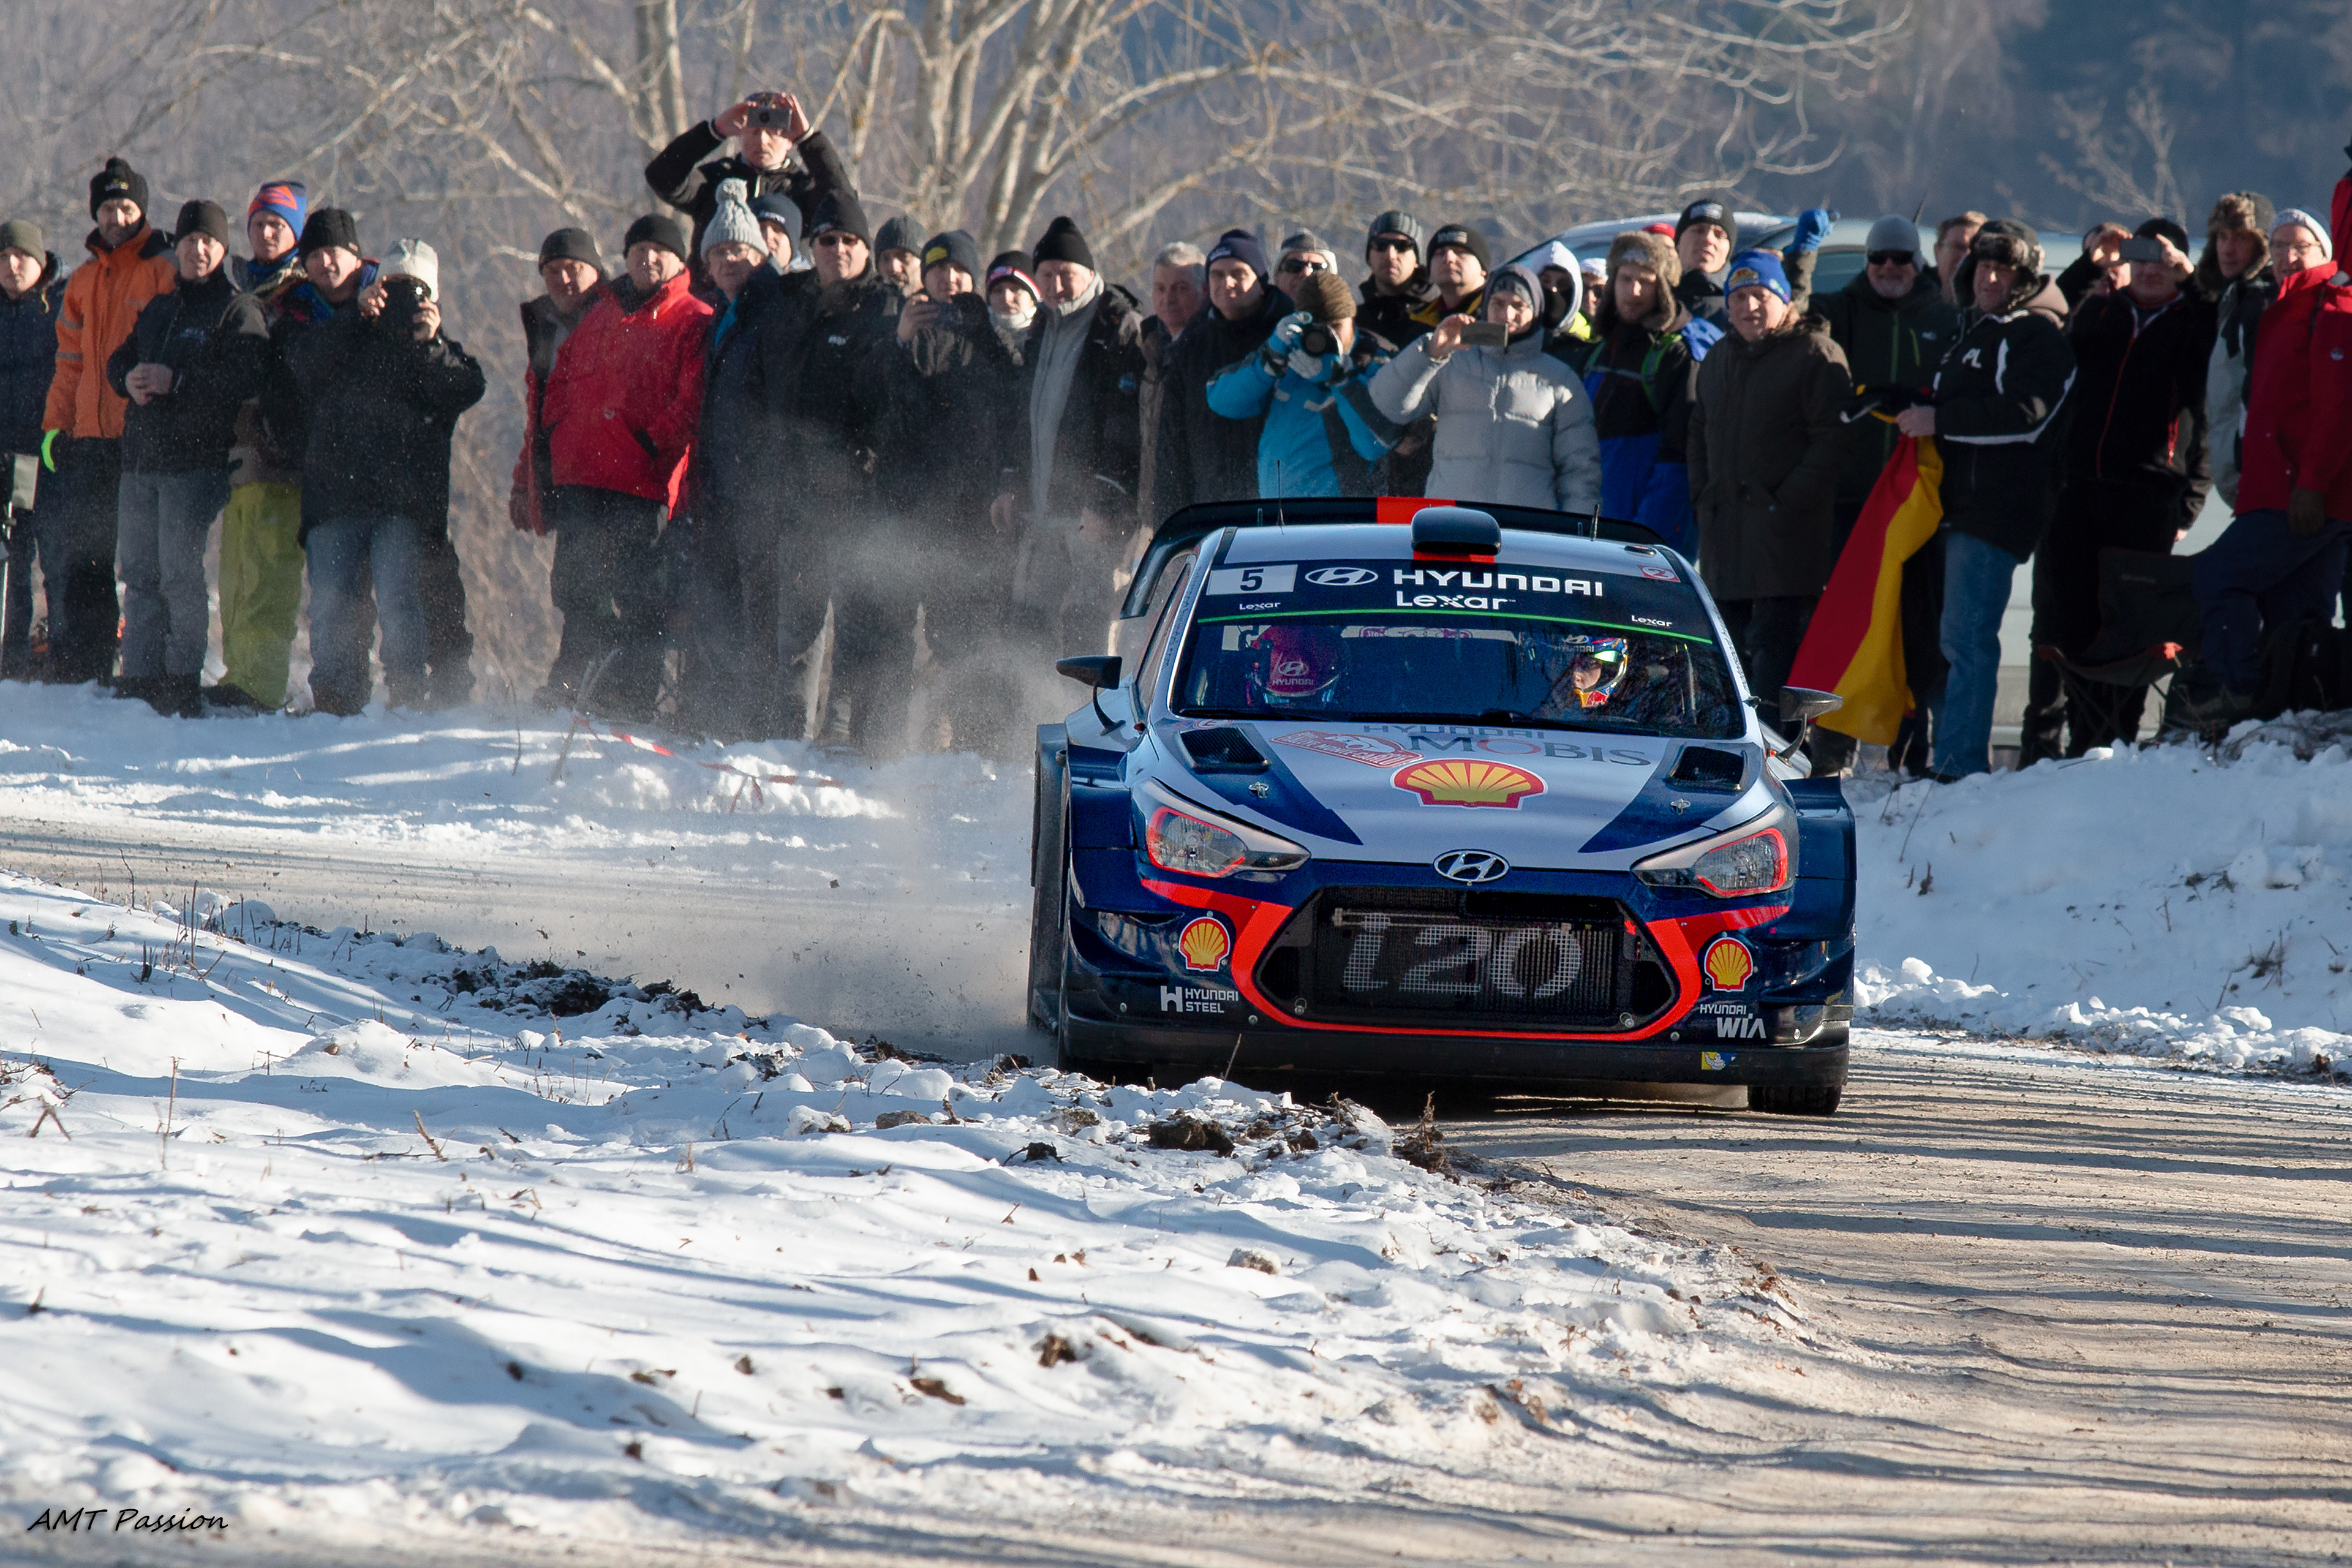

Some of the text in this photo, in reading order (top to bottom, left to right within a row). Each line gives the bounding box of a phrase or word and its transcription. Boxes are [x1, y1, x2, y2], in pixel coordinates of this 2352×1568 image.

[1240, 568, 1263, 590] 5
[1393, 569, 1603, 597] HYUNDAI
[1239, 602, 1281, 611] Lexar
[1631, 614, 1673, 627] Lexar
[1363, 724, 1545, 739] HYUNDAI
[1408, 734, 1651, 766] MOBIS
[1185, 987, 1239, 1002] HYUNDAI
[1185, 1001, 1225, 1014] STEEL
[1699, 1003, 1747, 1015] HYUNDAI
